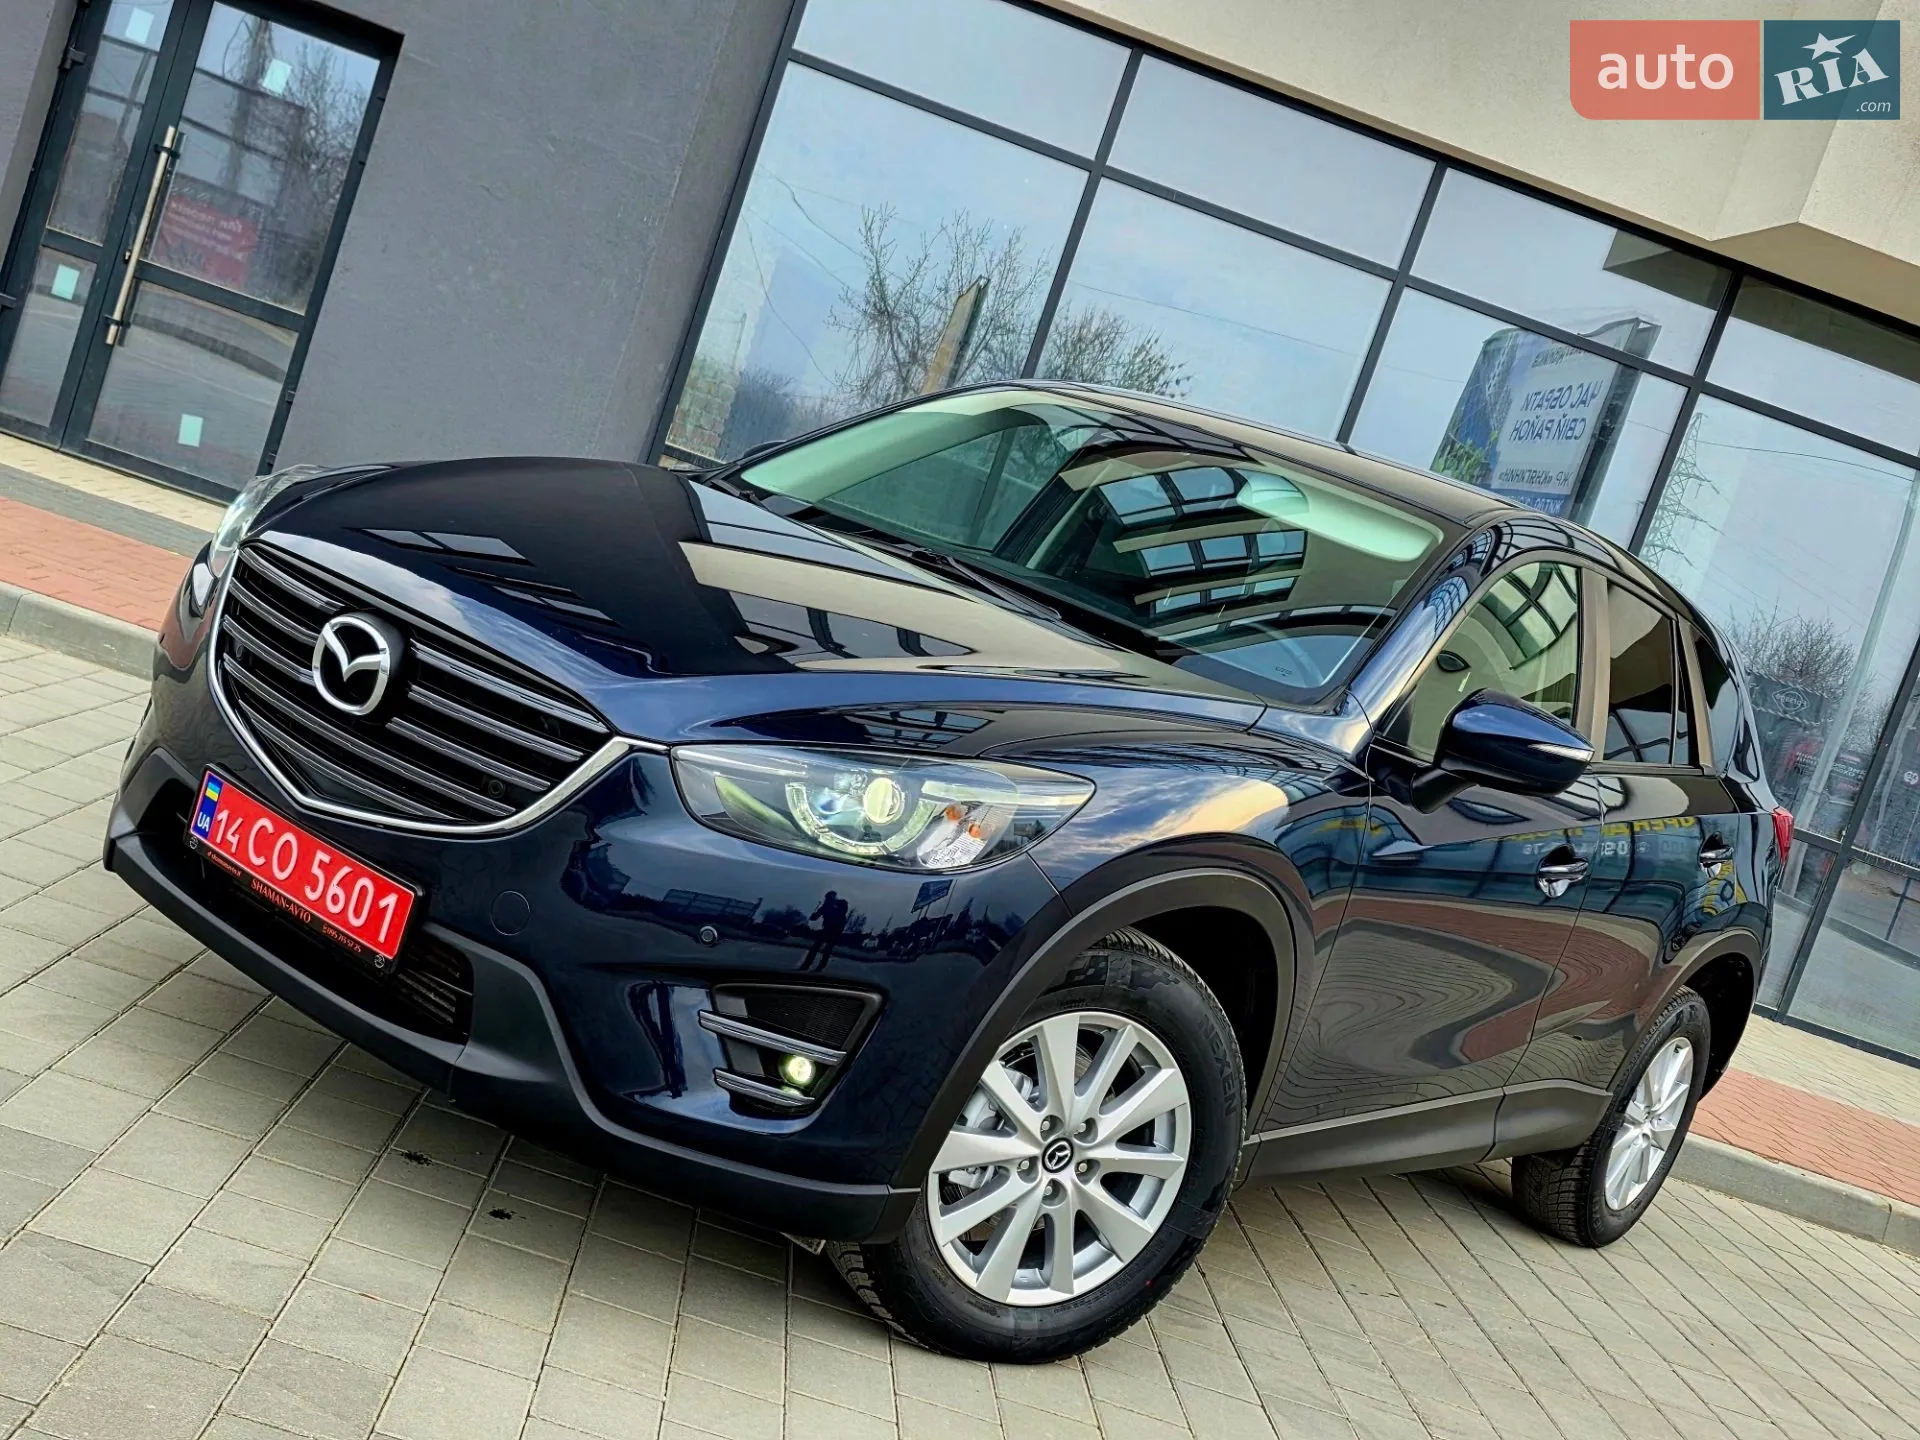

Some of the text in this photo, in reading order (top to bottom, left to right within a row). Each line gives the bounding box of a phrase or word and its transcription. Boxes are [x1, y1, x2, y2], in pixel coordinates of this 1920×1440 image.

[197, 813, 210, 832] UA
[216, 809, 243, 854] 14
[248, 817, 299, 881] CO
[304, 849, 399, 944] 5601
[251, 879, 311, 924] SHAMAN-AVTO
[1199, 1013, 1238, 1118] NEXEN
